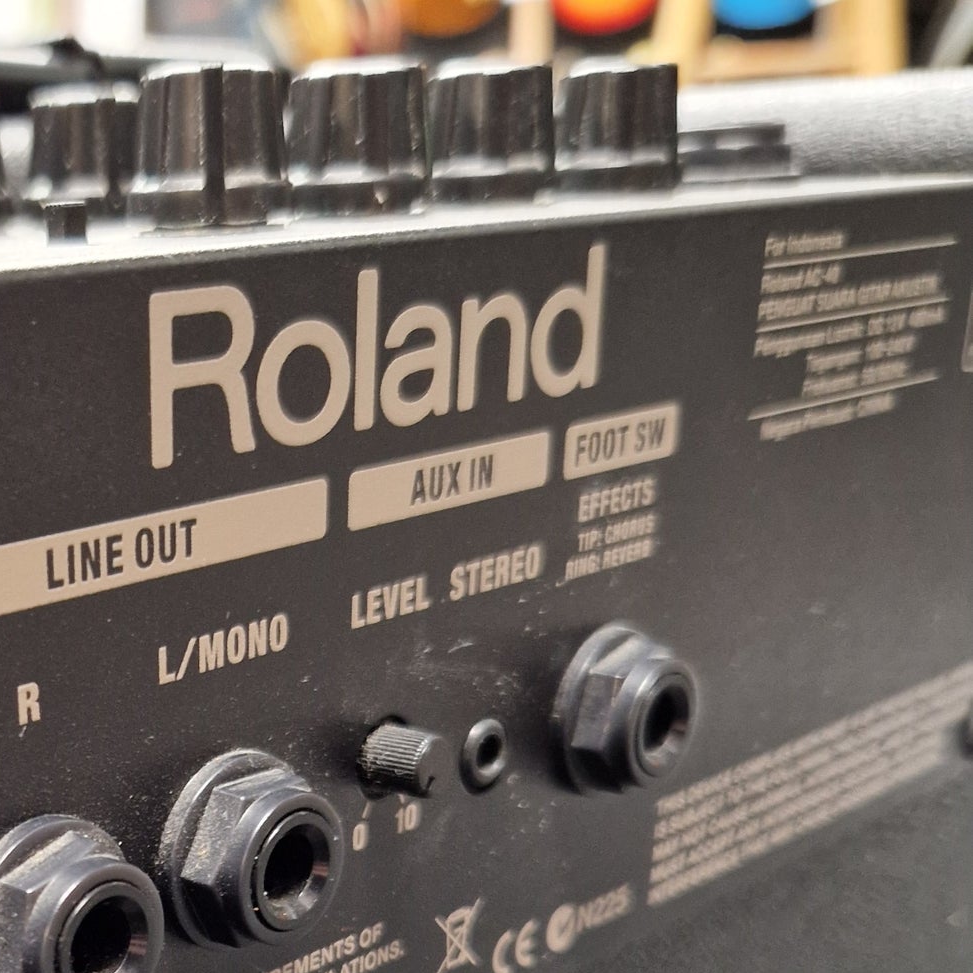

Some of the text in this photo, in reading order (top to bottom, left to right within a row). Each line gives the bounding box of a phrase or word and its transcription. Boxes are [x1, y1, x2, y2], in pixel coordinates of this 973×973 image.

[149, 242, 607, 470] Roland
[574, 418, 667, 468] FOOT SW
[410, 454, 494, 506] AUX IN
[578, 477, 657, 523] EFFECTS
[45, 518, 198, 590] LINE OUT
[449, 545, 543, 601] STEREO
[350, 576, 430, 629] LEVEL
[157, 613, 289, 685] L/MONO
[17, 682, 41, 725] R
[353, 823, 368, 851] 0
[395, 803, 419, 834] 10
[358, 922, 384, 948] OF
